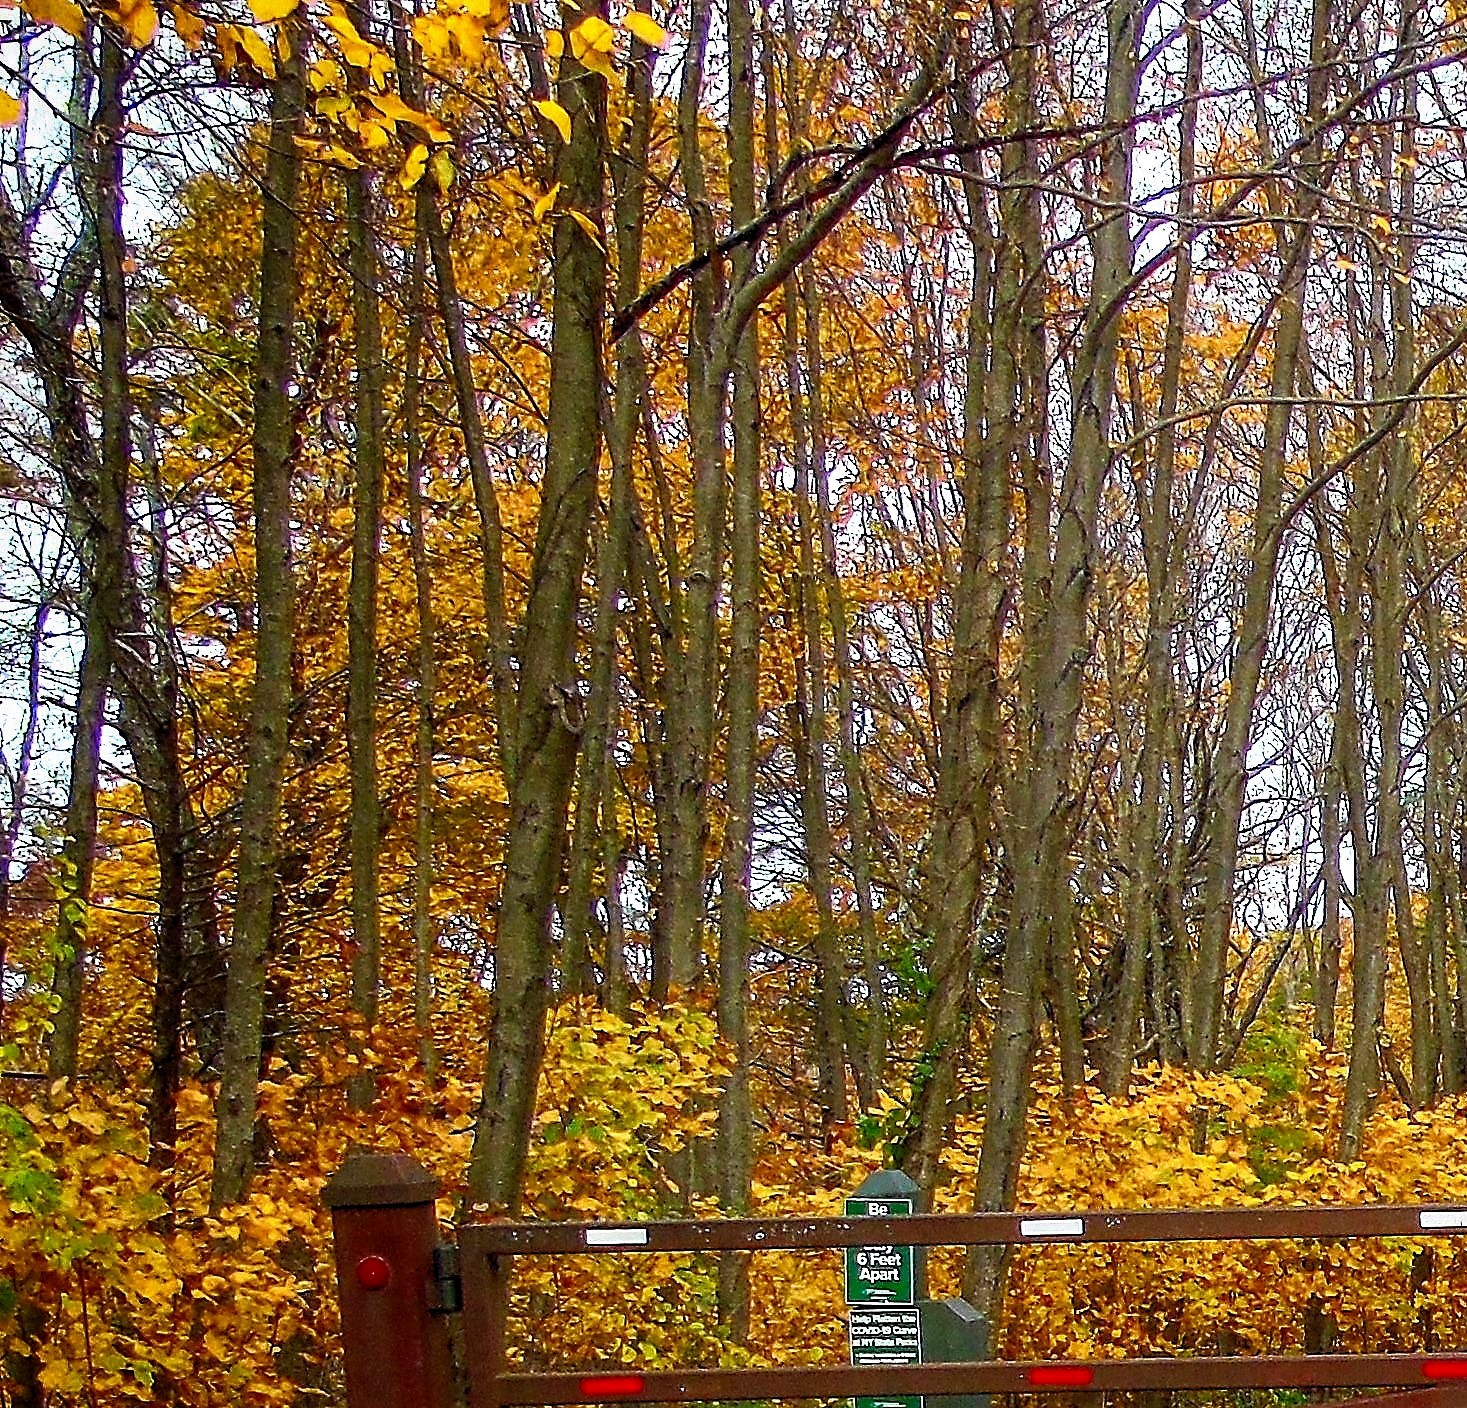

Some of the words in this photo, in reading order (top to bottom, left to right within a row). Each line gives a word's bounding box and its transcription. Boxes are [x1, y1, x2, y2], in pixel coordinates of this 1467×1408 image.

[868, 1202, 889, 1216] Be
[856, 1252, 868, 1266] 6
[870, 1252, 902, 1266] Feet
[859, 1267, 900, 1284] Apart
[892, 1326, 918, 1335] Curve
